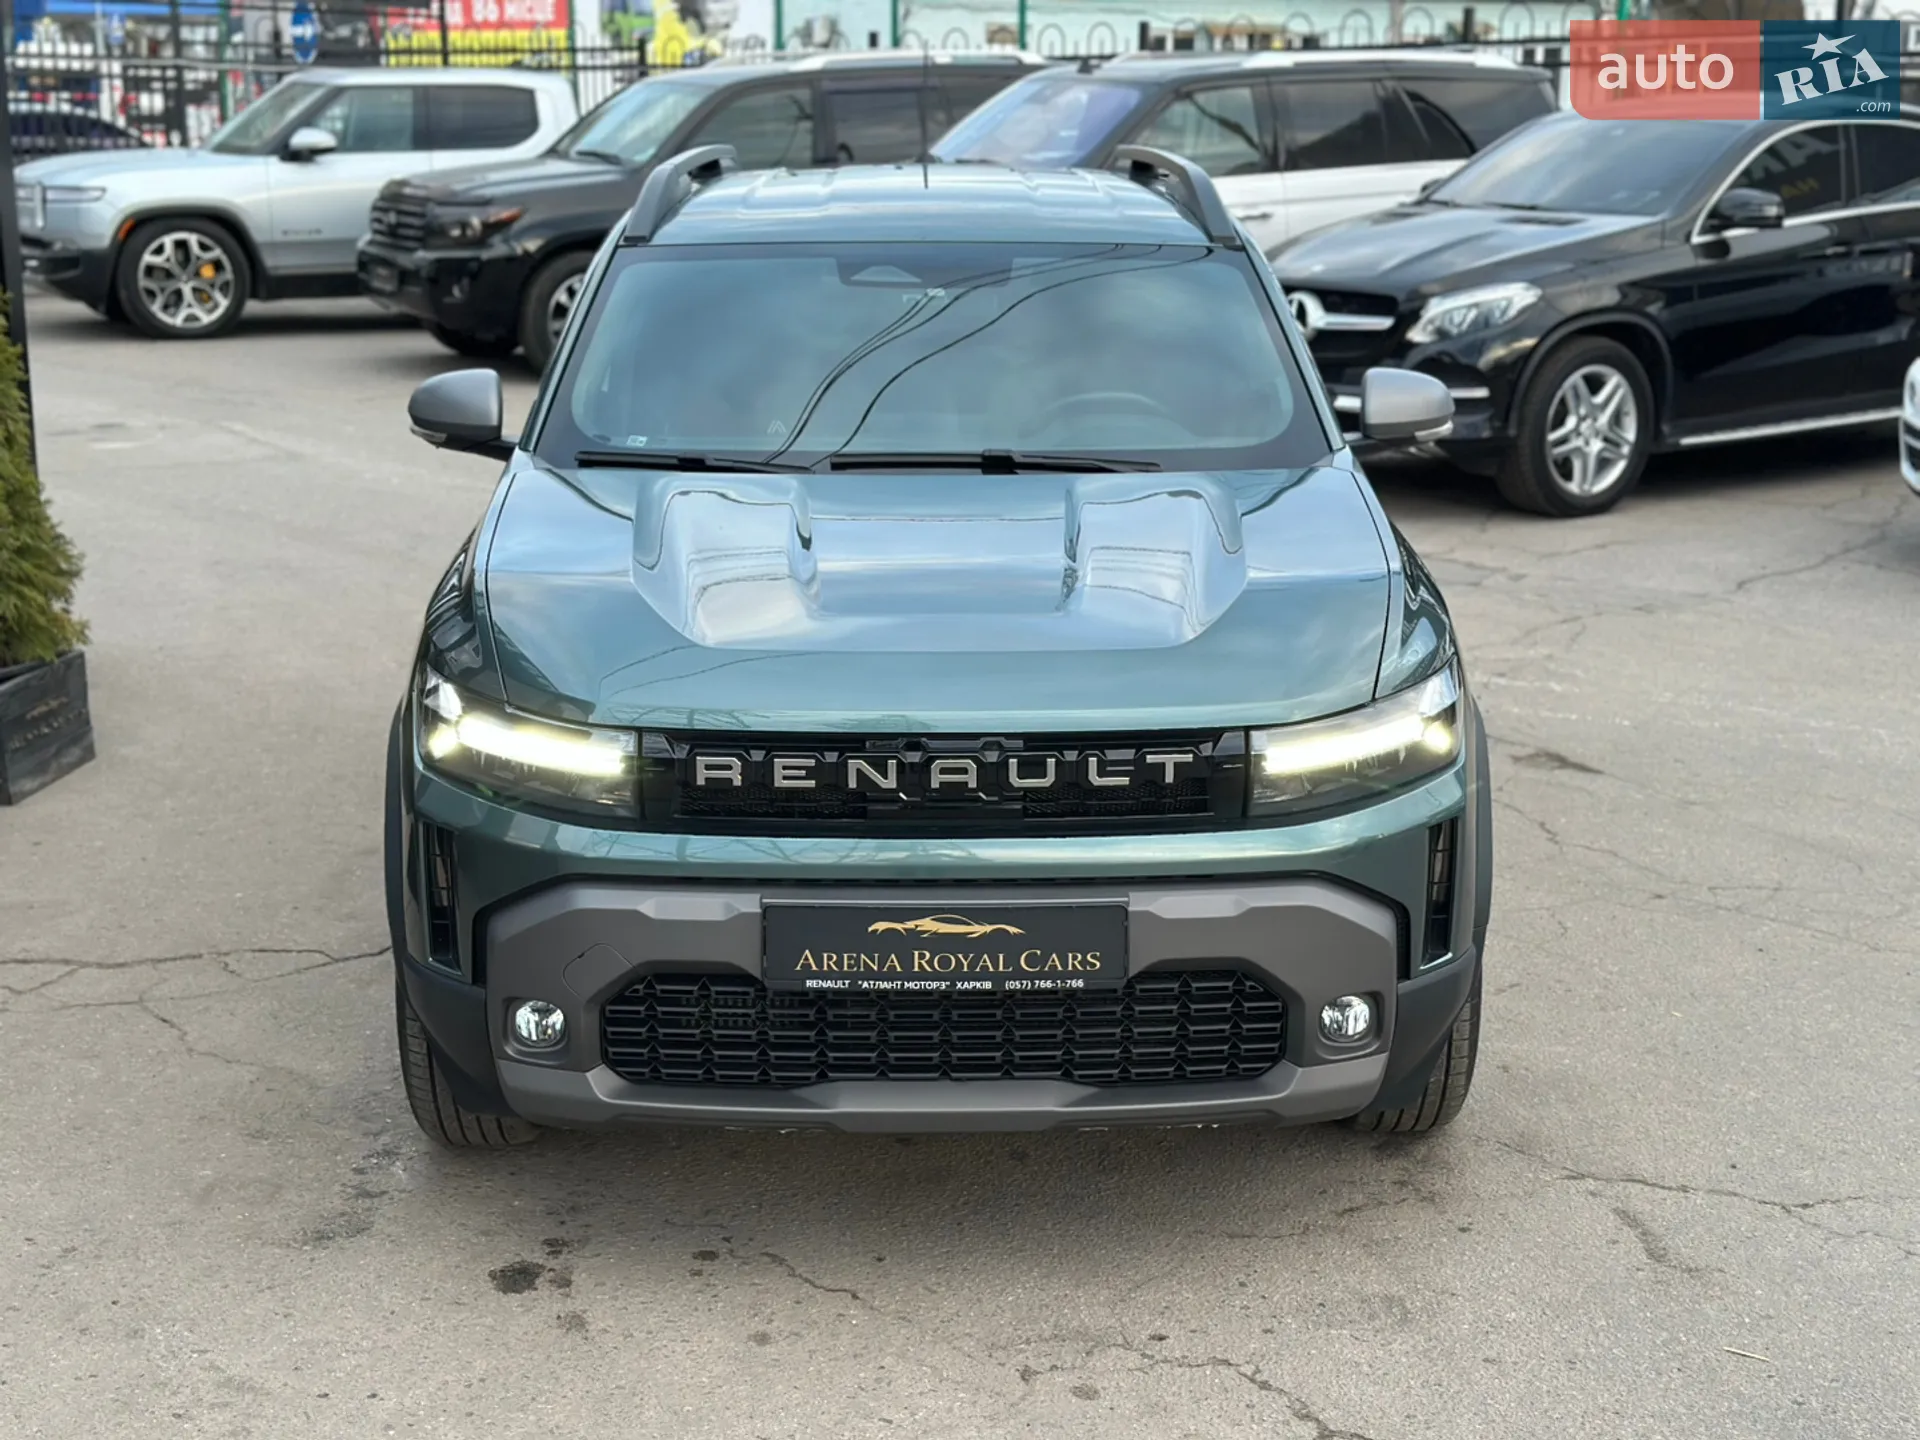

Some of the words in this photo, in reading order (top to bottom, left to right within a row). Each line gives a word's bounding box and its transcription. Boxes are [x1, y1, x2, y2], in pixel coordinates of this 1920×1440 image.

[696, 753, 1194, 789] RENAULT
[805, 979, 851, 989] RENAULT
[858, 981, 902, 990] "АТЛАНТ
[904, 981, 951, 990] МОТОРЗ"
[956, 981, 992, 990] ХАРКІВ
[1005, 980, 1031, 990] (057)
[1033, 978, 1084, 989] 766-1-766
